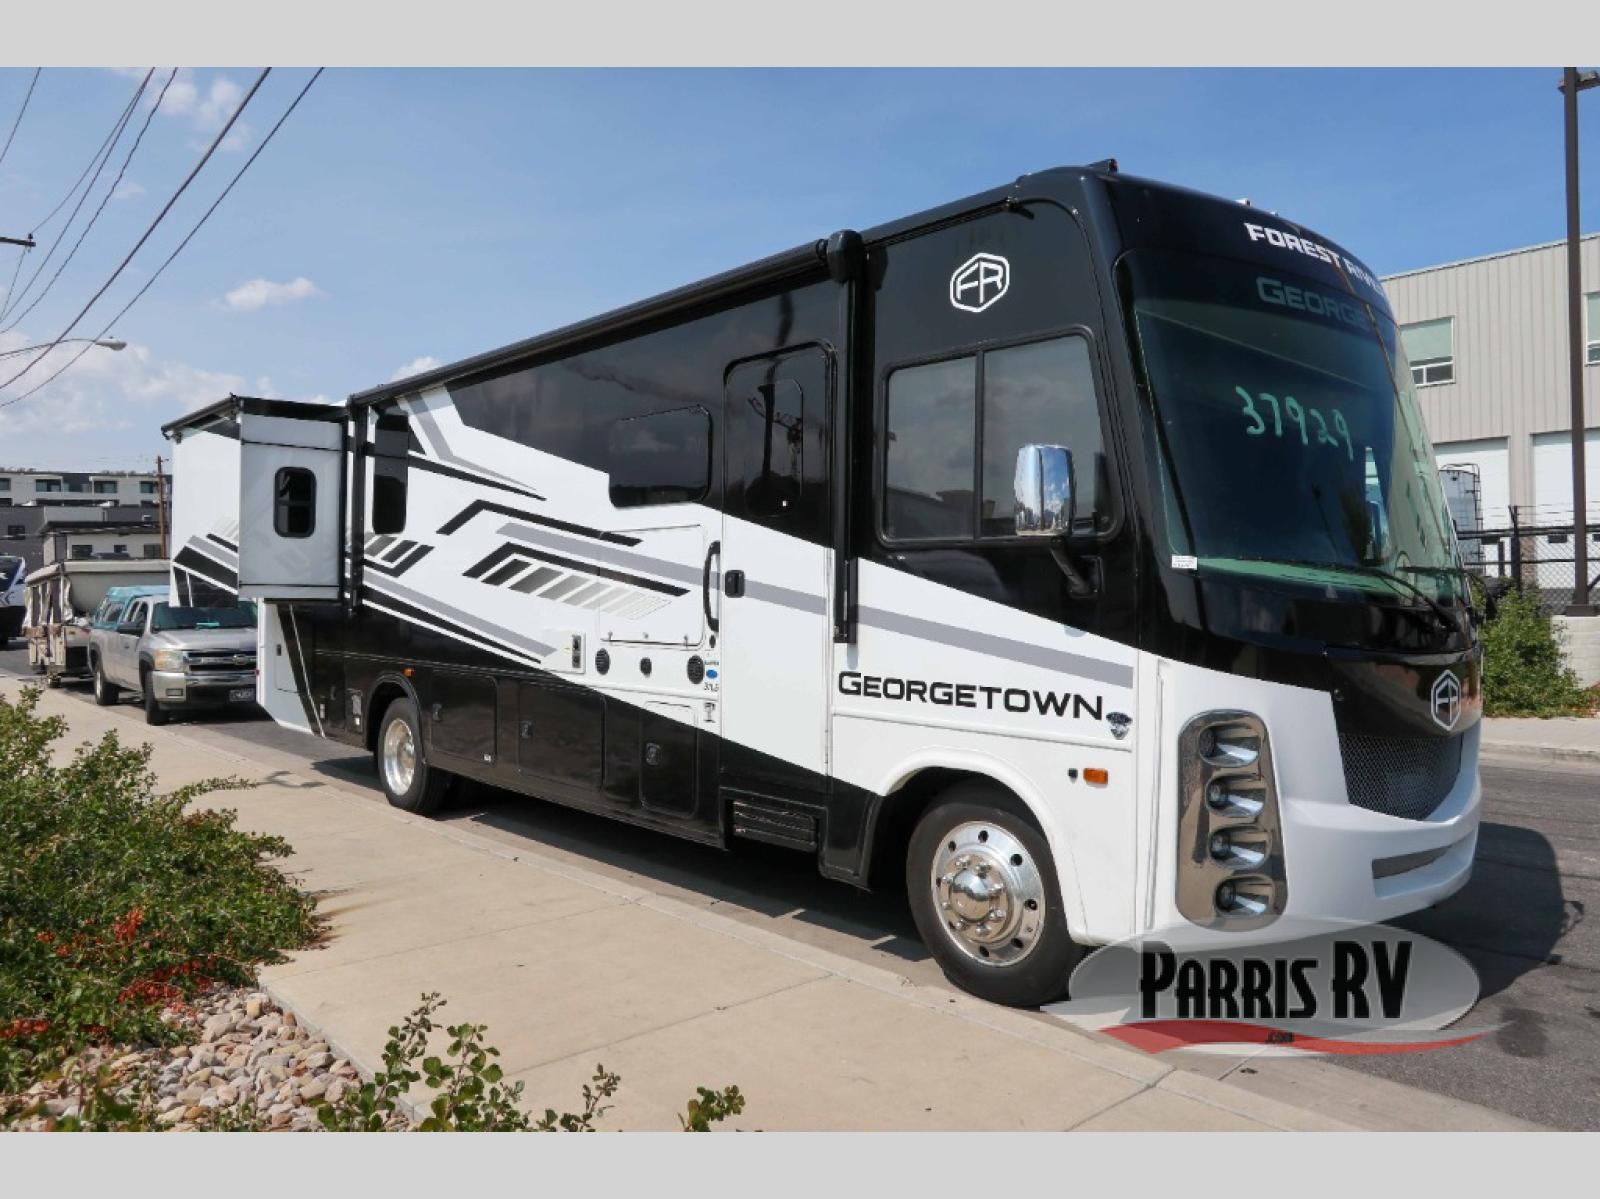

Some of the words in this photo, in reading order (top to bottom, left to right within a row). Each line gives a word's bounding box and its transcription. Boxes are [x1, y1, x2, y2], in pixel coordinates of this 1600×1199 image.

[1244, 222, 1341, 269] FOREST
[1235, 385, 1354, 461] 37929
[838, 670, 1102, 721] GEORGETOWN
